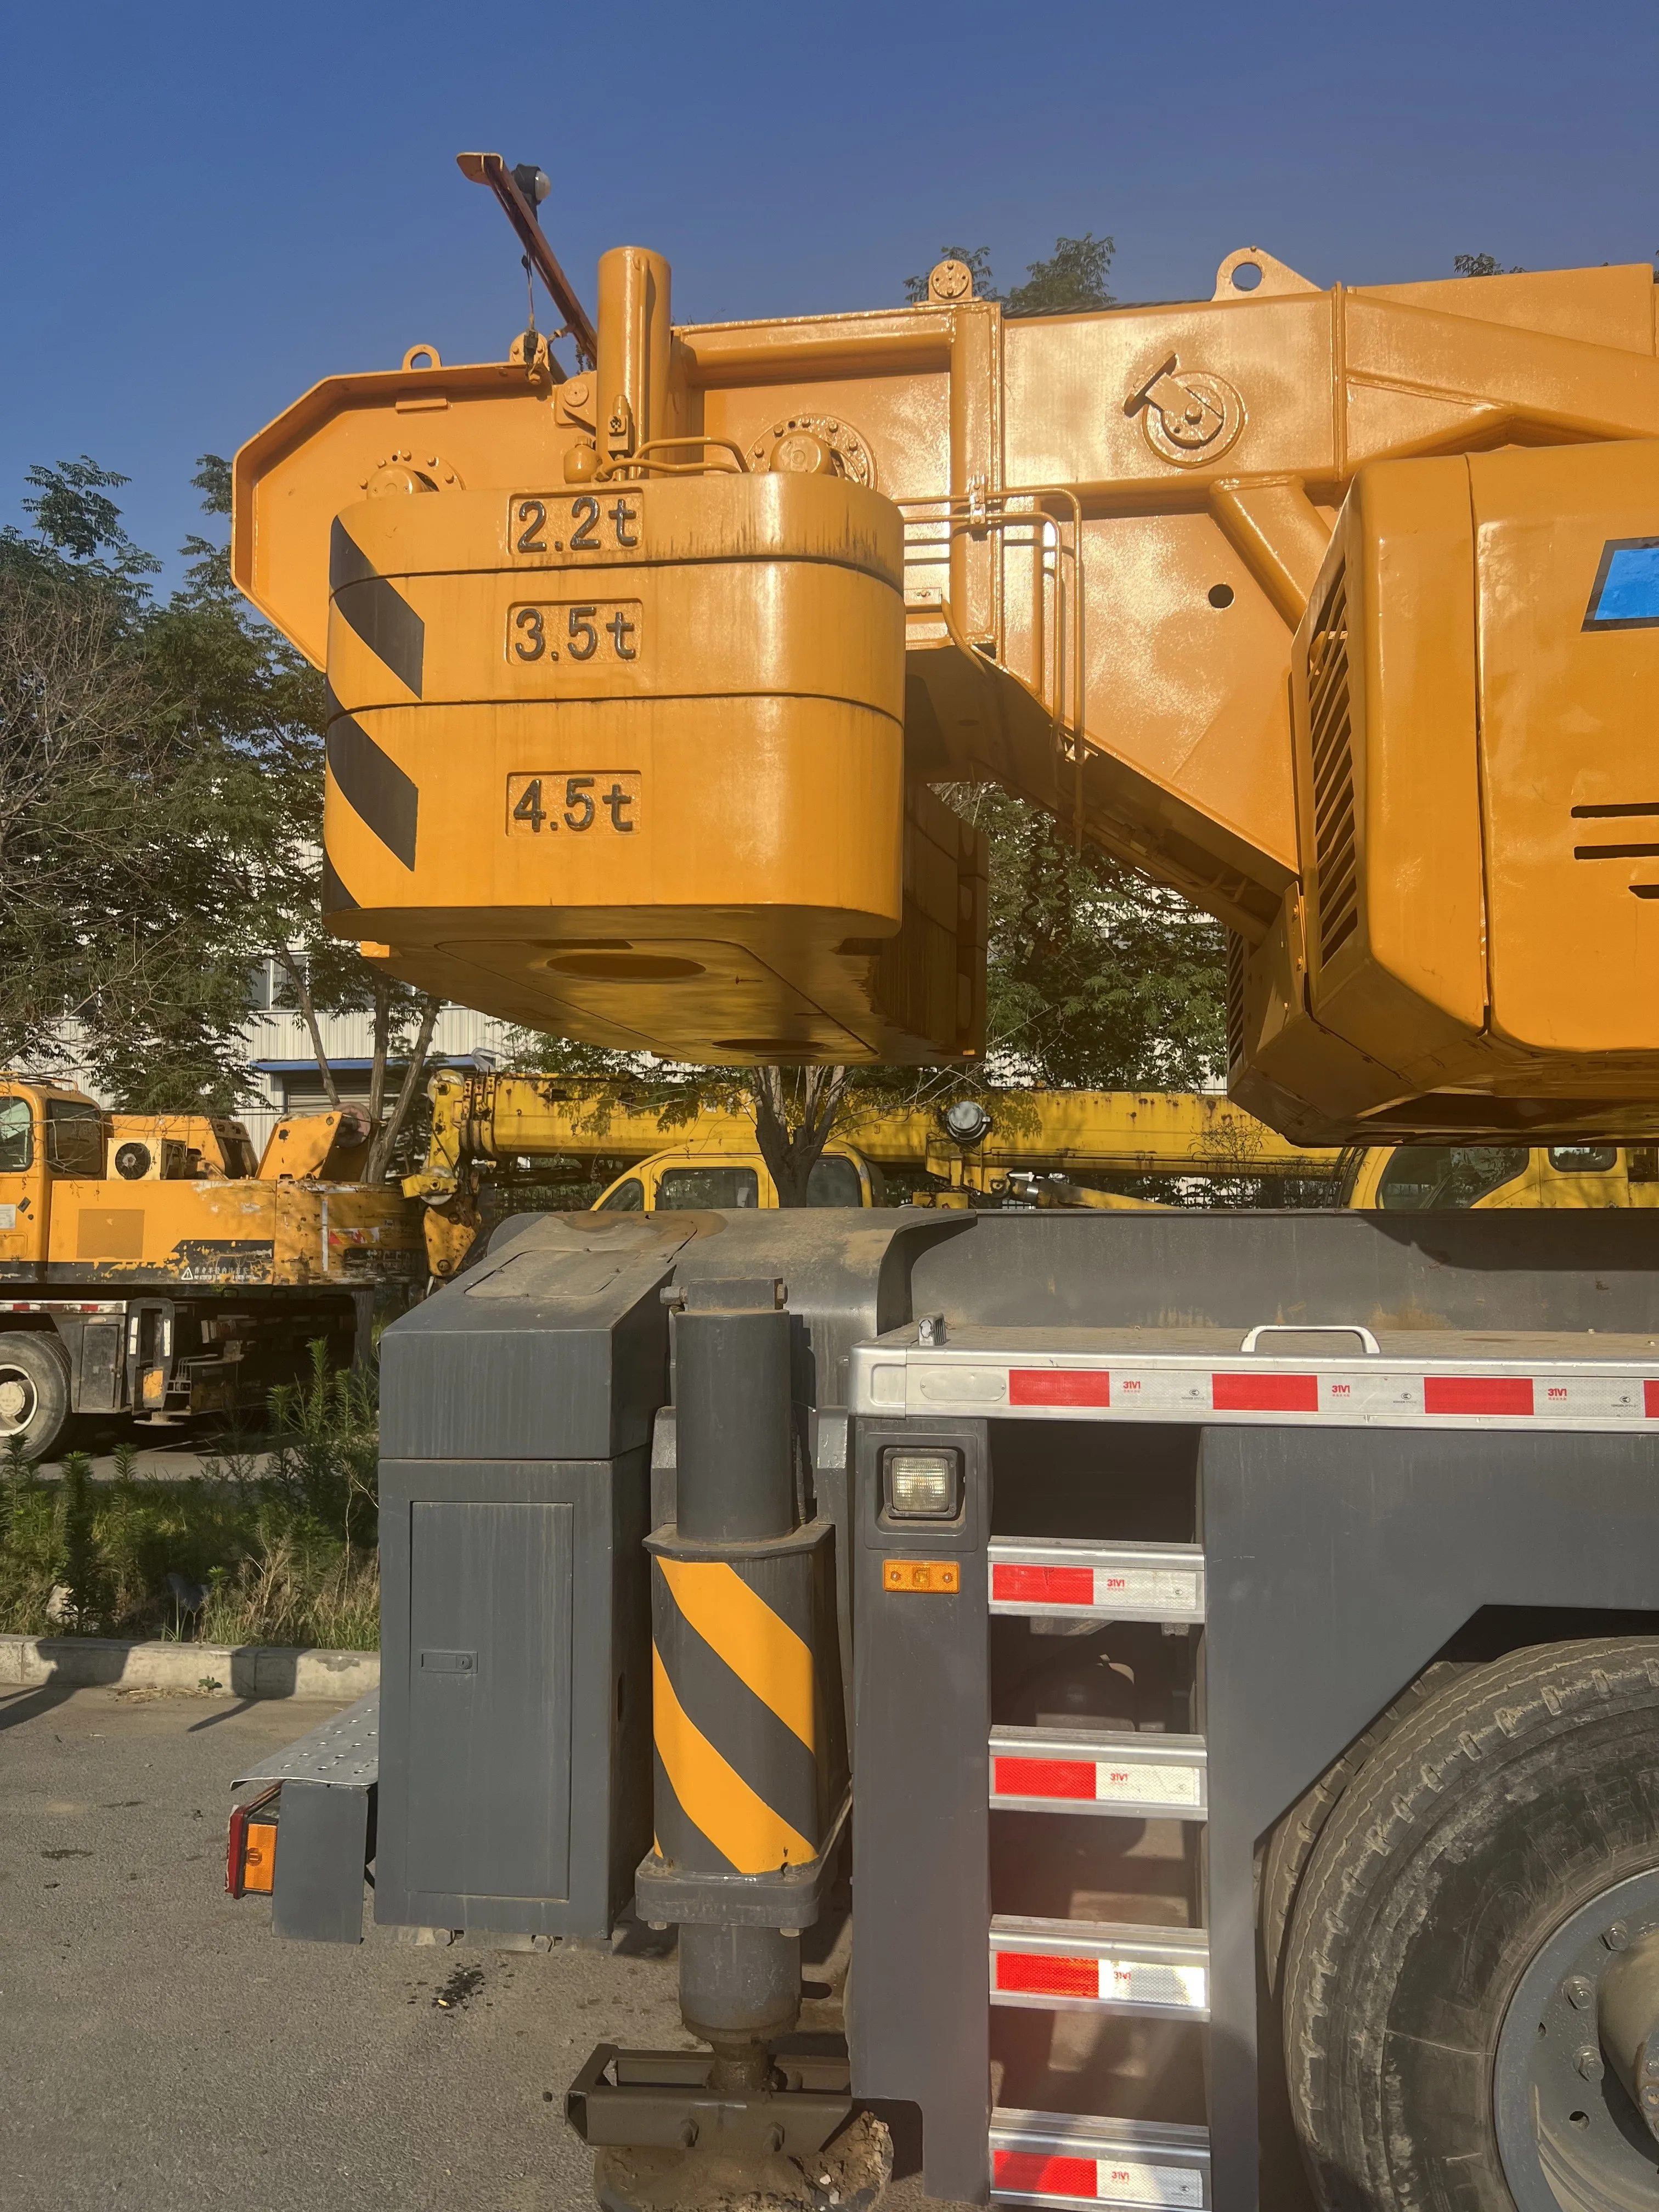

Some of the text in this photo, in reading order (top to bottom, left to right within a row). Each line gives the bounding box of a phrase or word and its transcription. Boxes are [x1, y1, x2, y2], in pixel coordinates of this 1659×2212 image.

[517, 496, 636, 553] 2.2t
[515, 607, 636, 661] 3.5t
[513, 777, 633, 832] 4.5t
